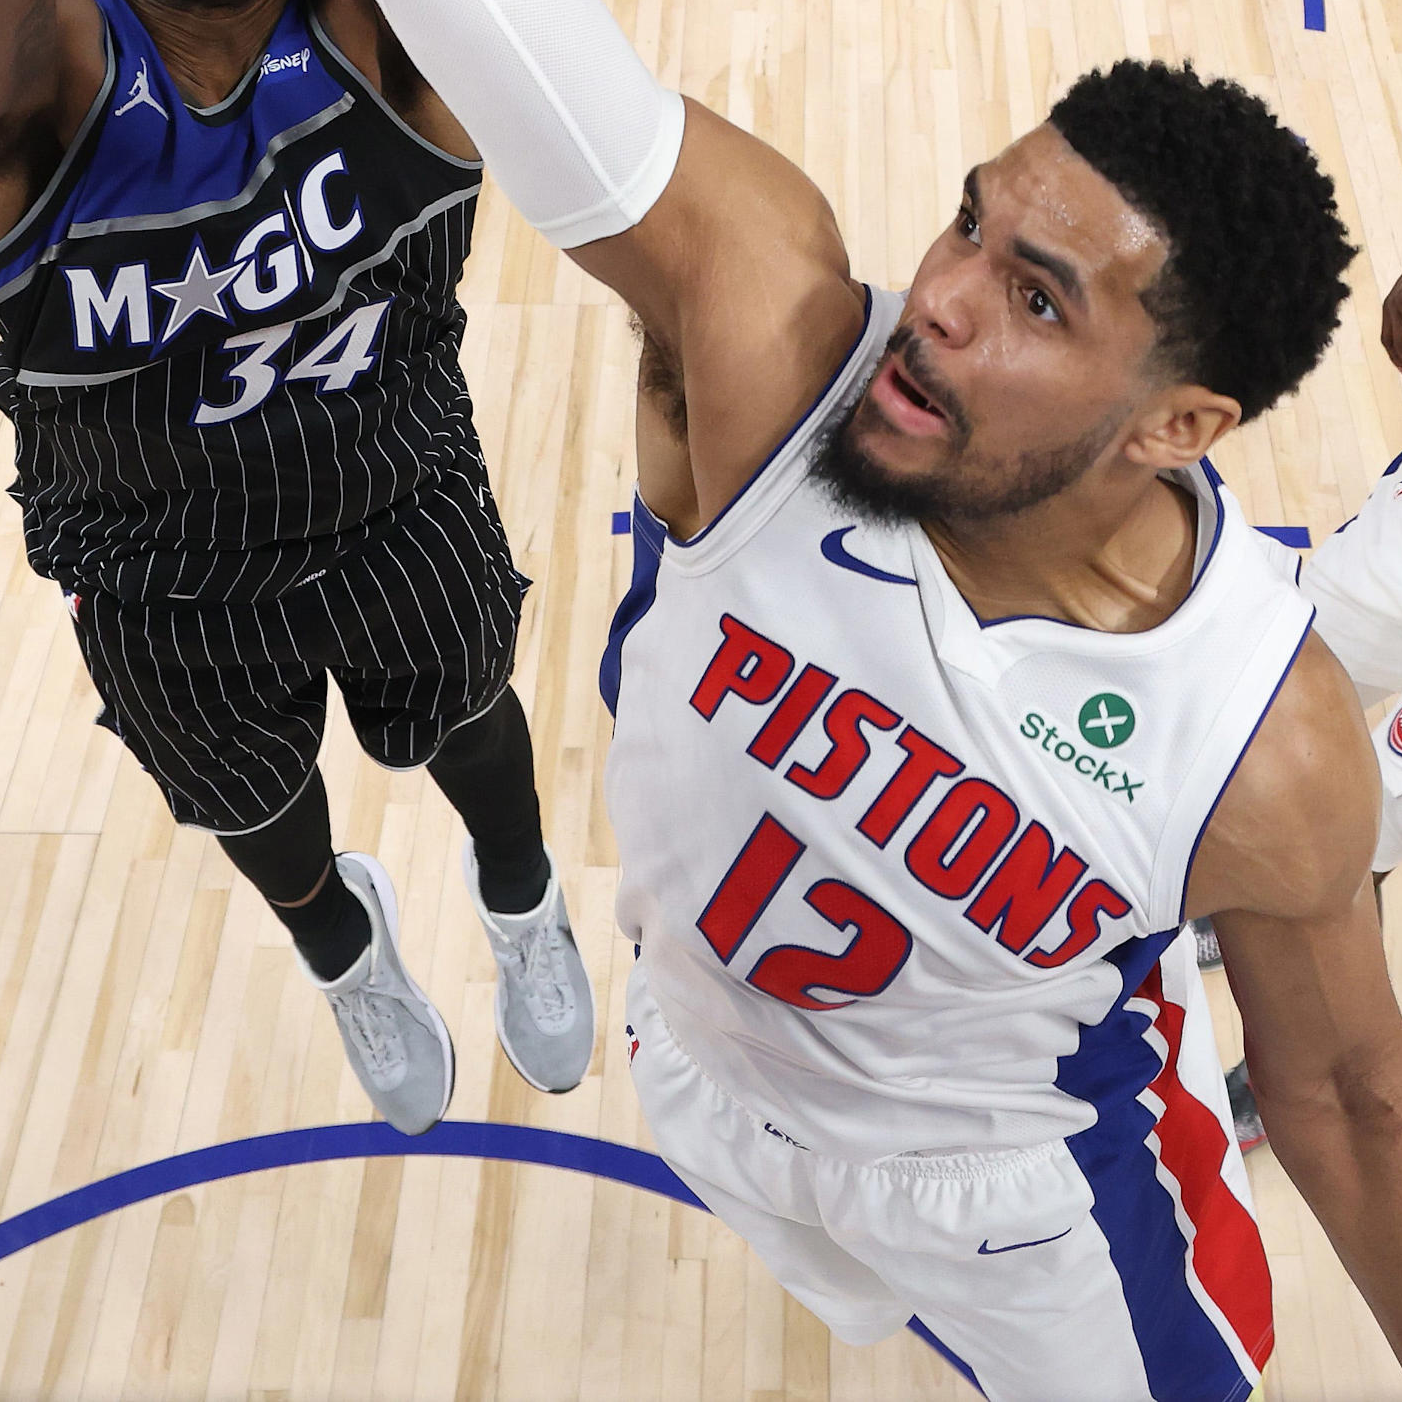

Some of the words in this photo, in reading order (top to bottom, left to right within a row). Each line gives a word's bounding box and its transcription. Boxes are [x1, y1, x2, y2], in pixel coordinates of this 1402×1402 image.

[63, 149, 365, 355] MAGC
[188, 294, 396, 427] 34
[689, 612, 1133, 969] PISTONS
[694, 809, 914, 1011] 12
